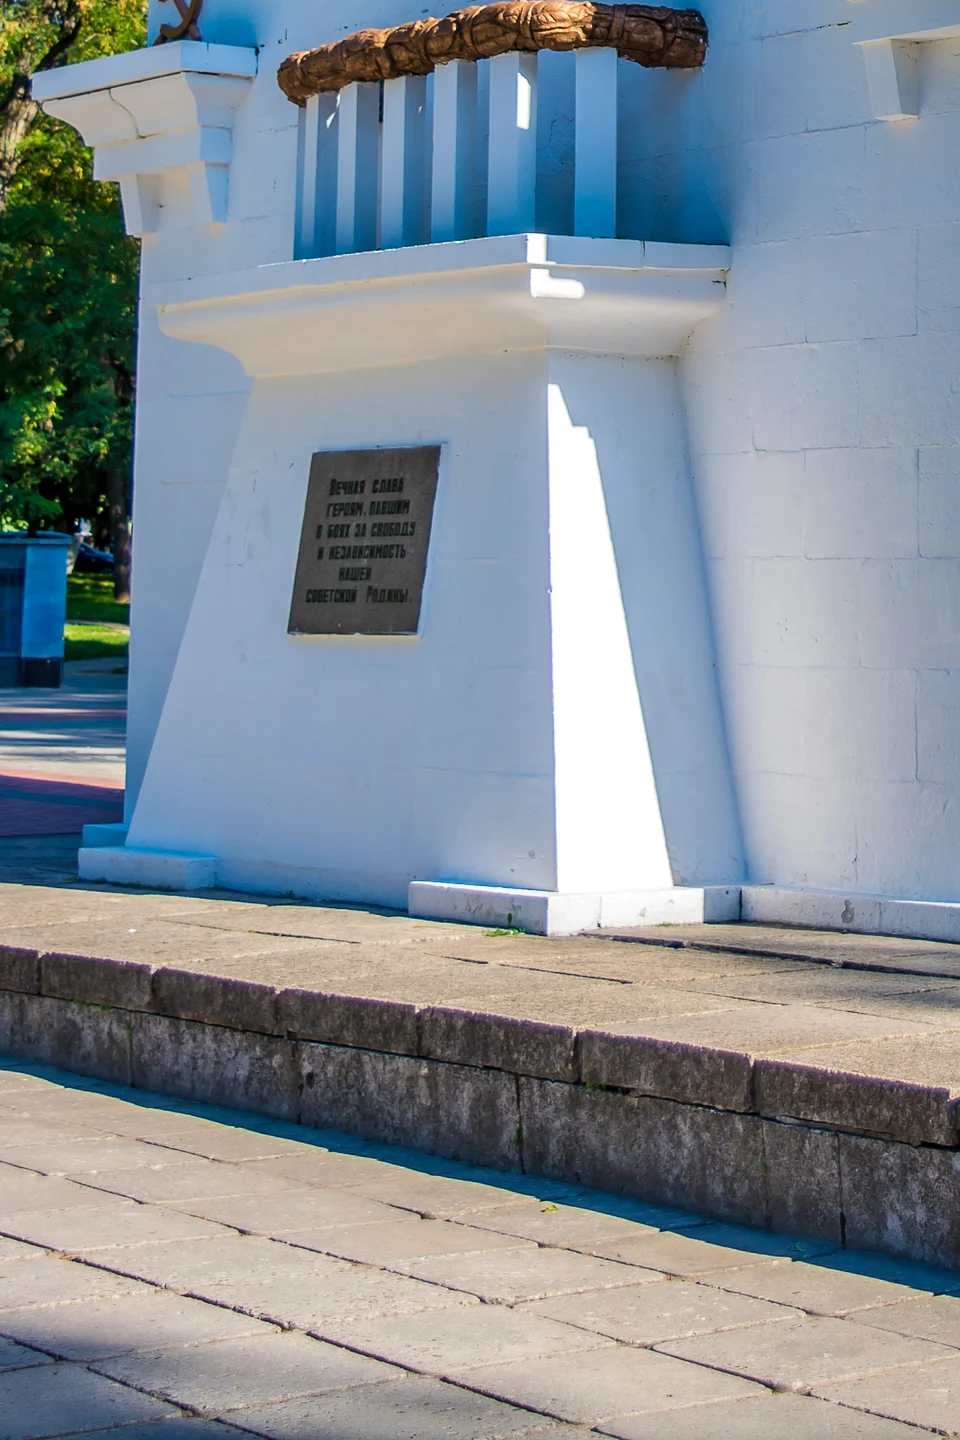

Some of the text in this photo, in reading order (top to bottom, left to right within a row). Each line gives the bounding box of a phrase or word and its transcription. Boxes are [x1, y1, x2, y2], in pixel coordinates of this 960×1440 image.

[369, 500, 411, 516] ПАВШИМ
[316, 521, 417, 539] В БОЯХ ЗА СВОБОДУ
[328, 544, 407, 560] НЕЗАВИСИМОСТЬ
[305, 586, 358, 603] СОВЕТСКОЙ
